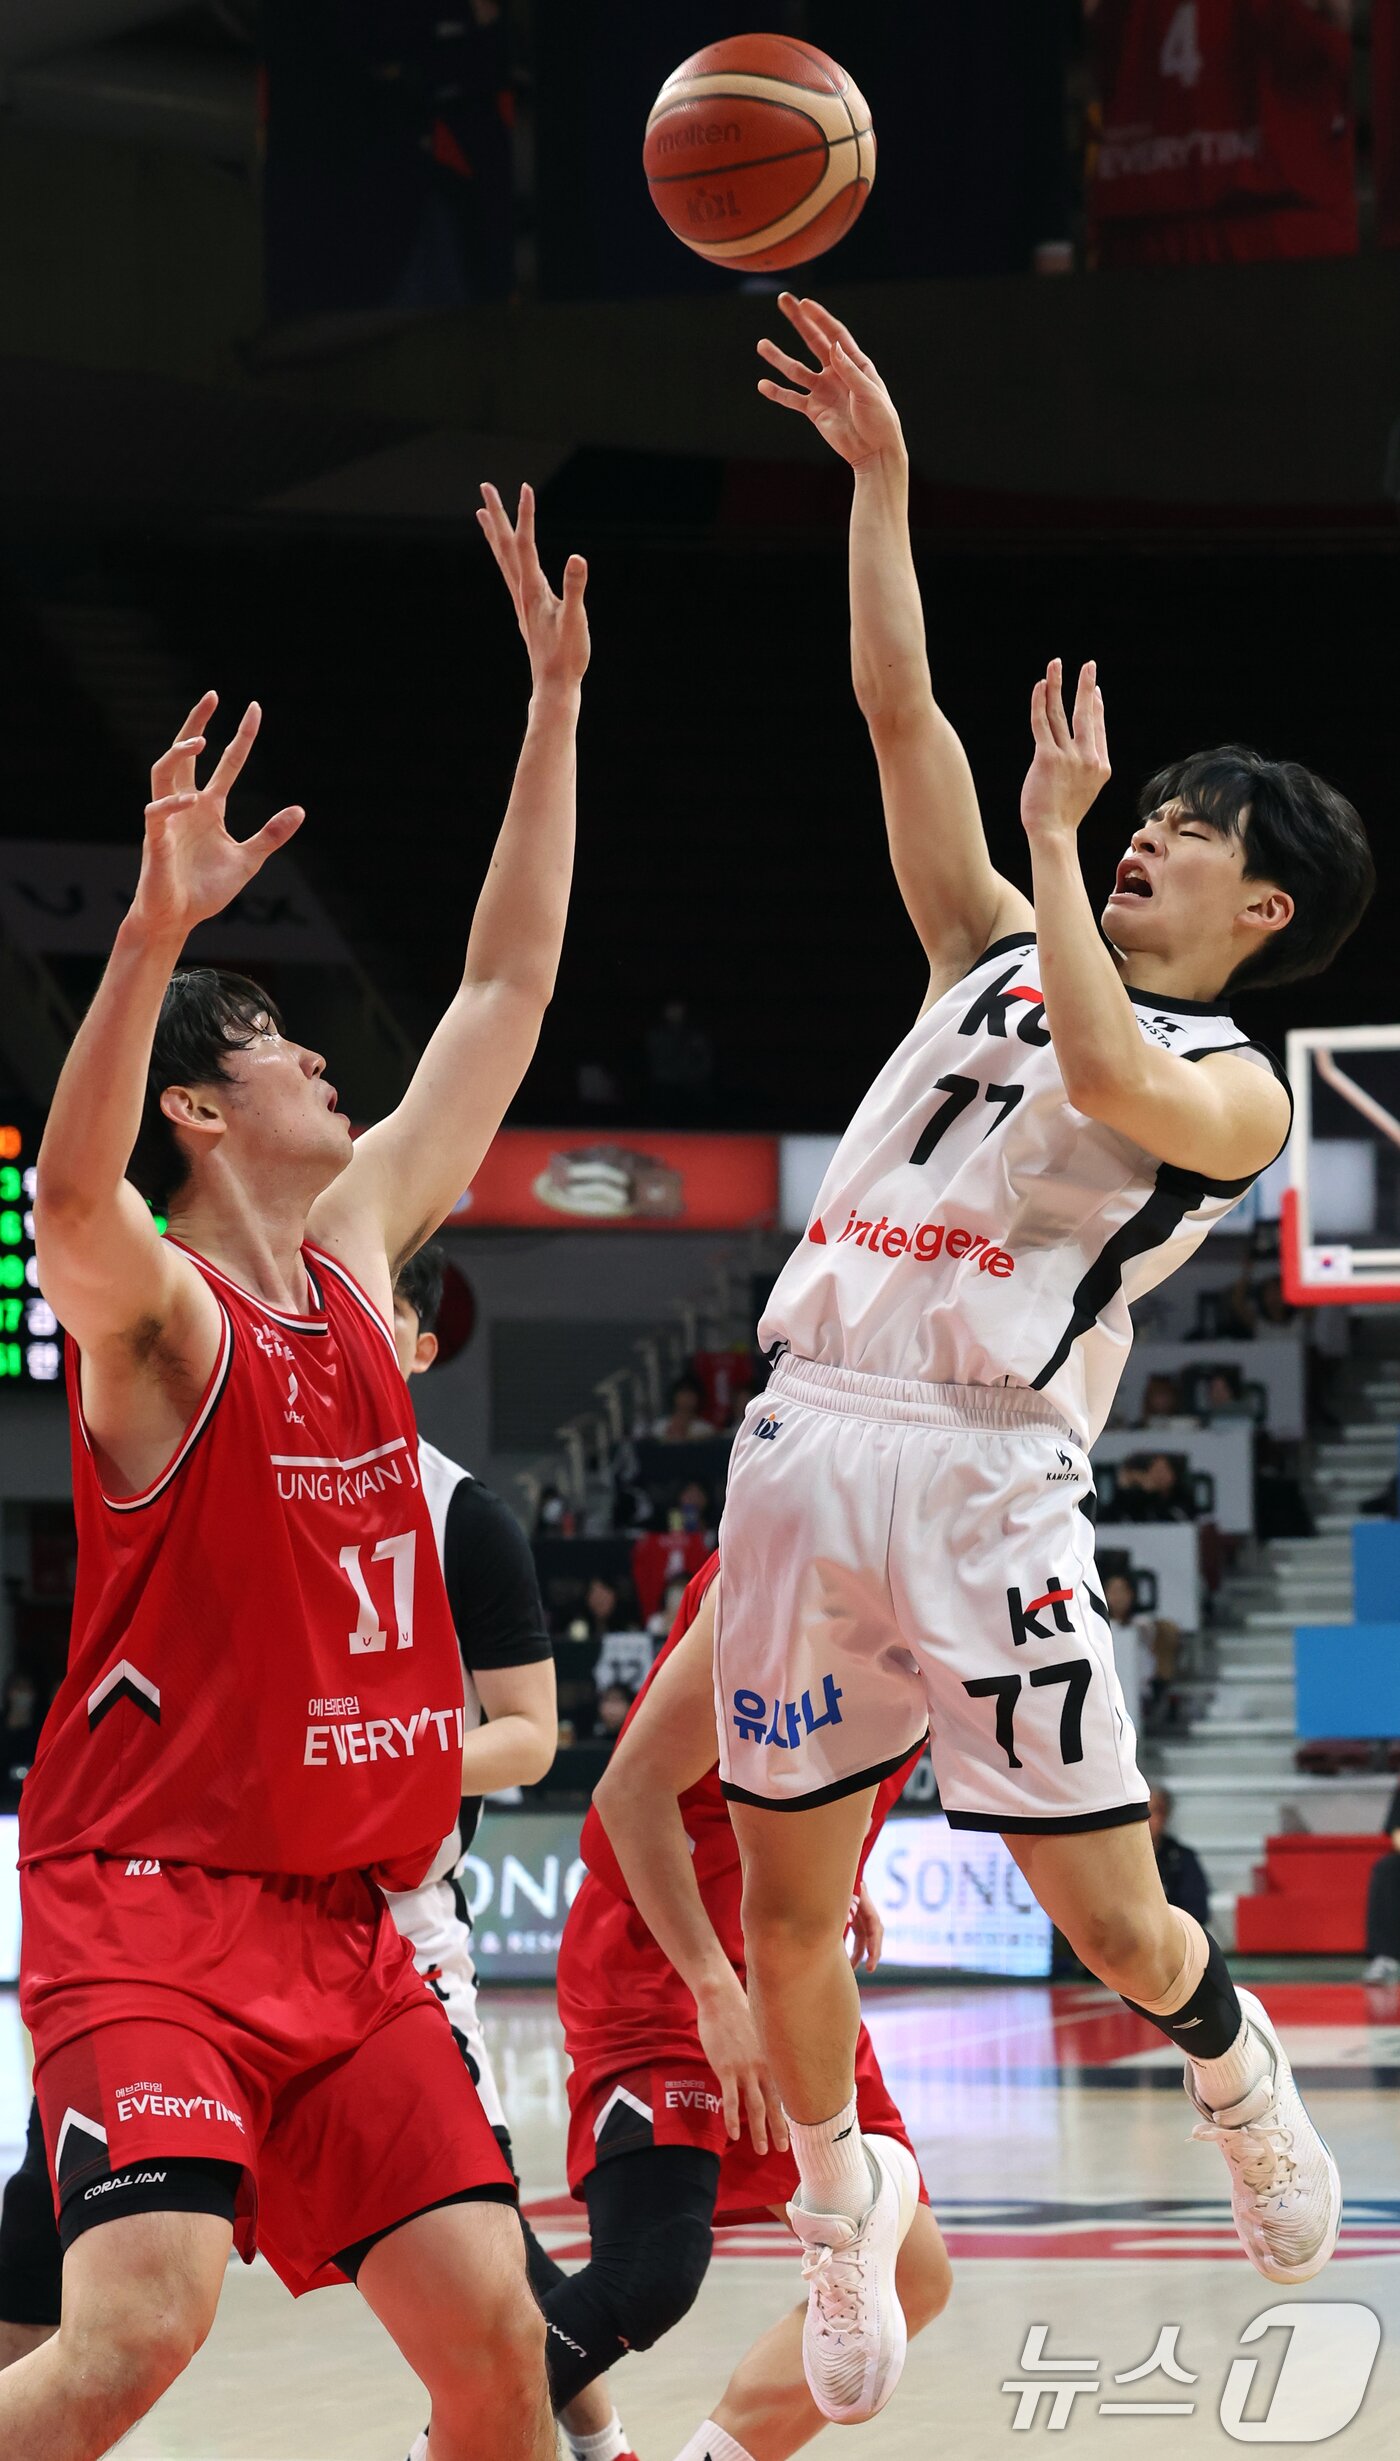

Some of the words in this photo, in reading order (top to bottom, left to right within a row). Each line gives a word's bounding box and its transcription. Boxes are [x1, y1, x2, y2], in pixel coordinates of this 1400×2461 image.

[656, 123, 742, 153] molten
[908, 1073, 1025, 1166] 77
[1046, 1472, 1079, 1481] KAMISTA
[339, 1530, 416, 1655] 17
[1007, 1577, 1076, 1646] kt
[733, 1673, 843, 1750] 유사나
[961, 1658, 1093, 1768] 77
[115, 2081, 162, 2099] 에브리타임
[84, 2172, 167, 2200] CORALIAN
